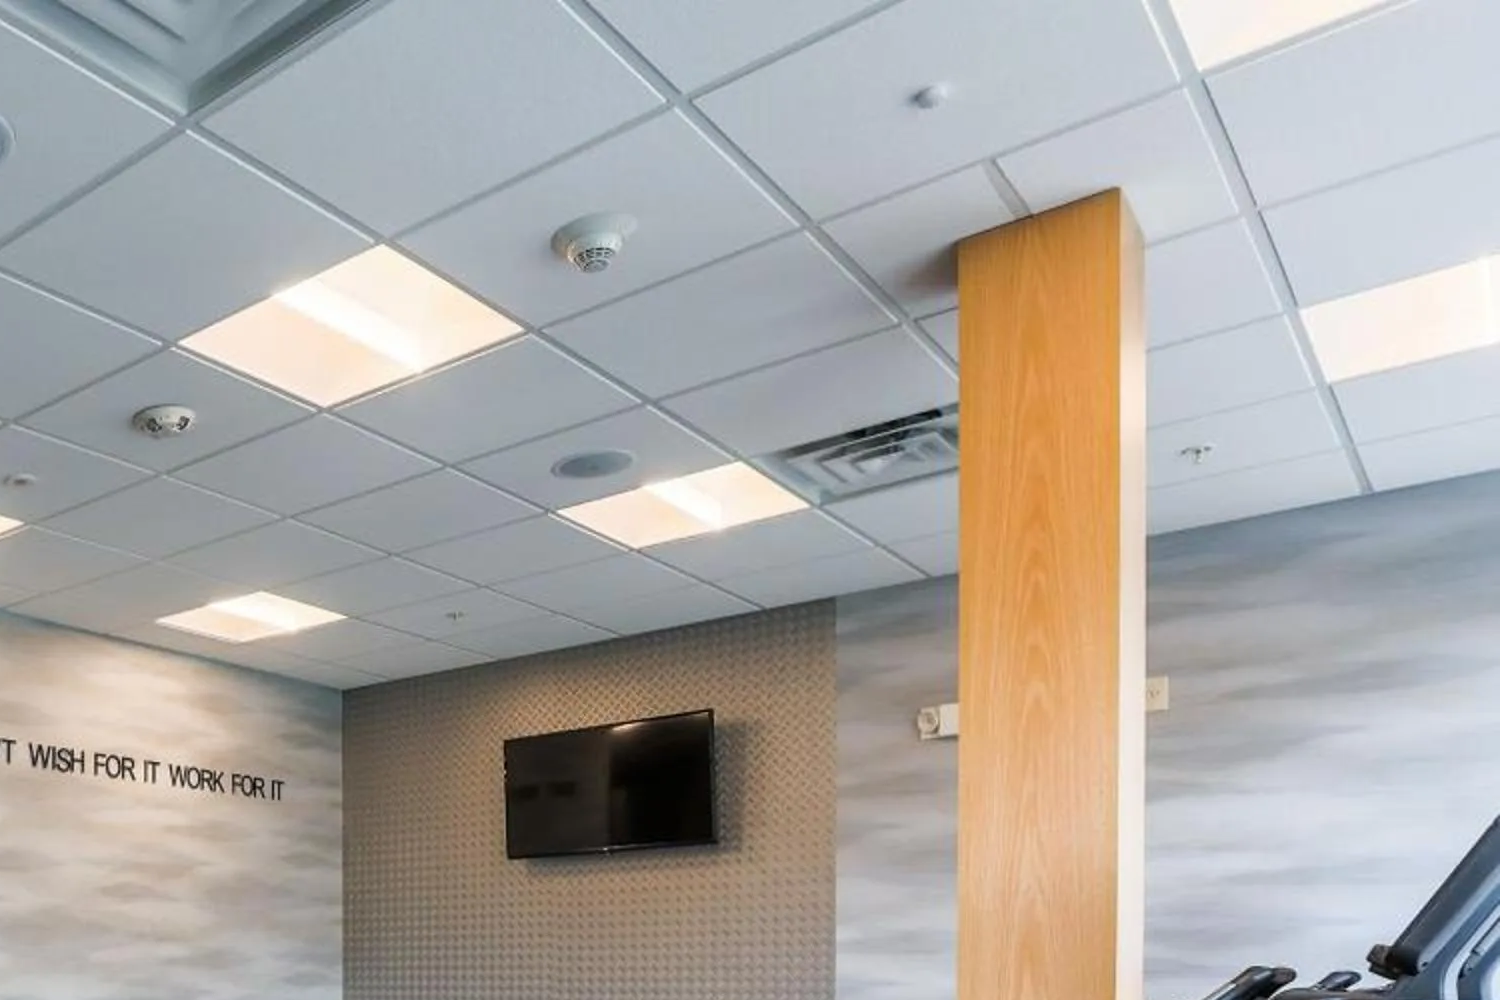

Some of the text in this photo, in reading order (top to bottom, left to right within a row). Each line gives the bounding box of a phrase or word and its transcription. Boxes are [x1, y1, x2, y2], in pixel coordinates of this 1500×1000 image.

[28, 742, 85, 774] WISH
[93, 752, 136, 782] FOR
[143, 760, 161, 784] IT
[168, 764, 225, 794] WORK
[231, 774, 265, 799] FOR
[271, 779, 285, 801] IT
